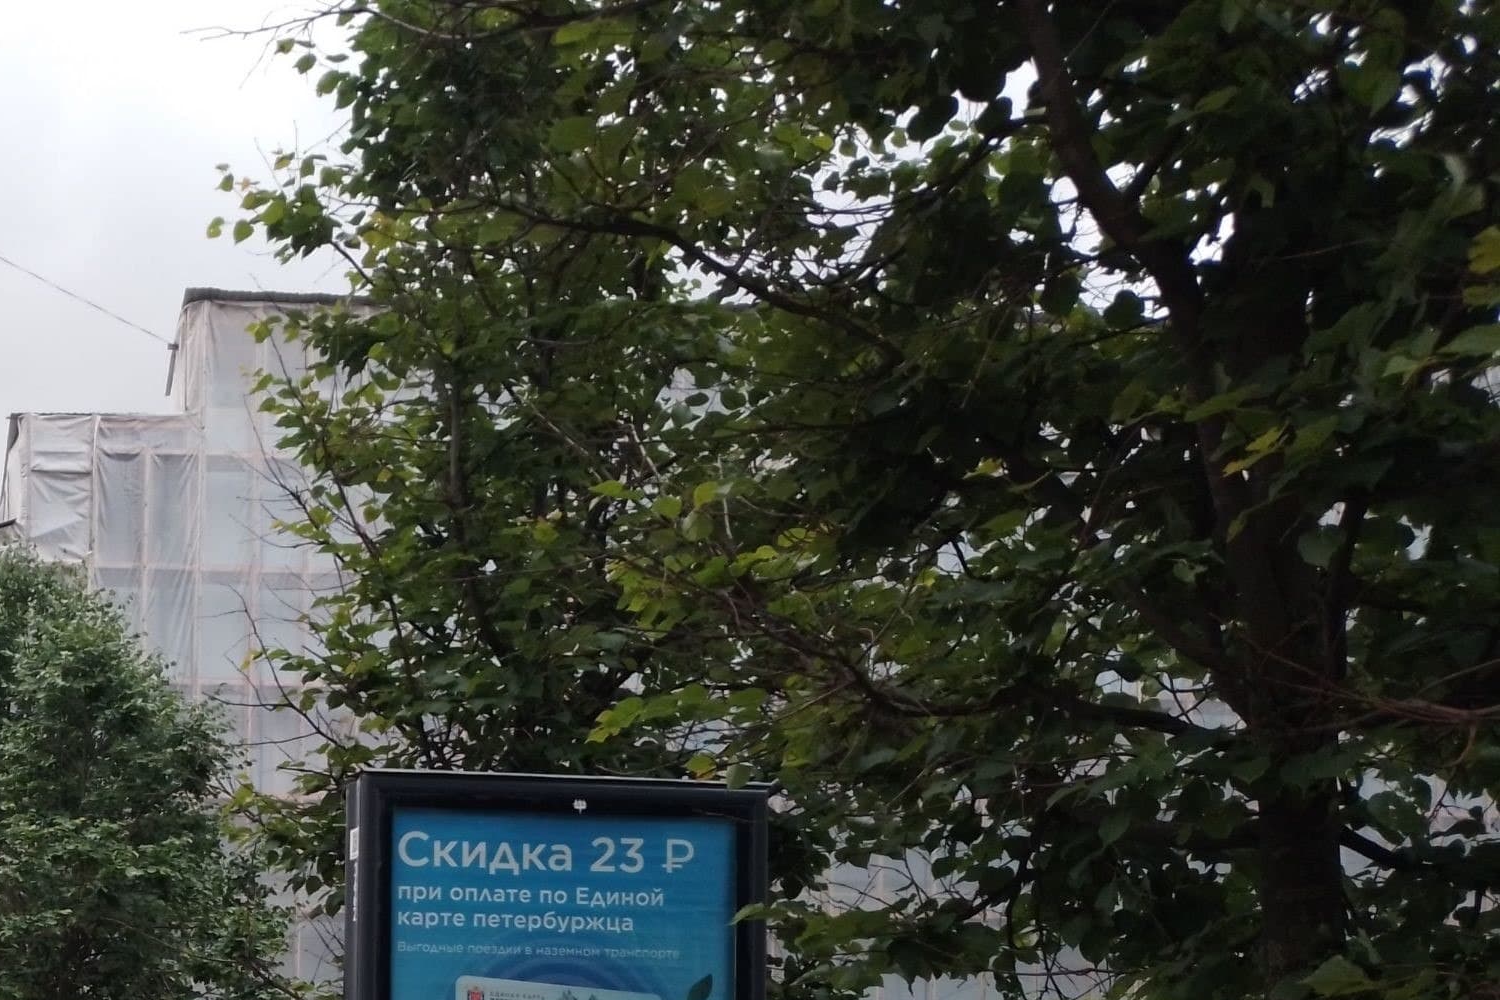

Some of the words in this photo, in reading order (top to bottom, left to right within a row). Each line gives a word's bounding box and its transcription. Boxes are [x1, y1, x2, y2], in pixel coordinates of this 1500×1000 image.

[397, 830, 573, 876] Скидка
[590, 836, 645, 873] 23
[398, 885, 442, 903] при
[449, 886, 532, 903] оплате
[539, 889, 568, 904] по
[575, 886, 665, 908] Единой
[397, 911, 466, 929] карте
[473, 911, 635, 934] петербуржца
